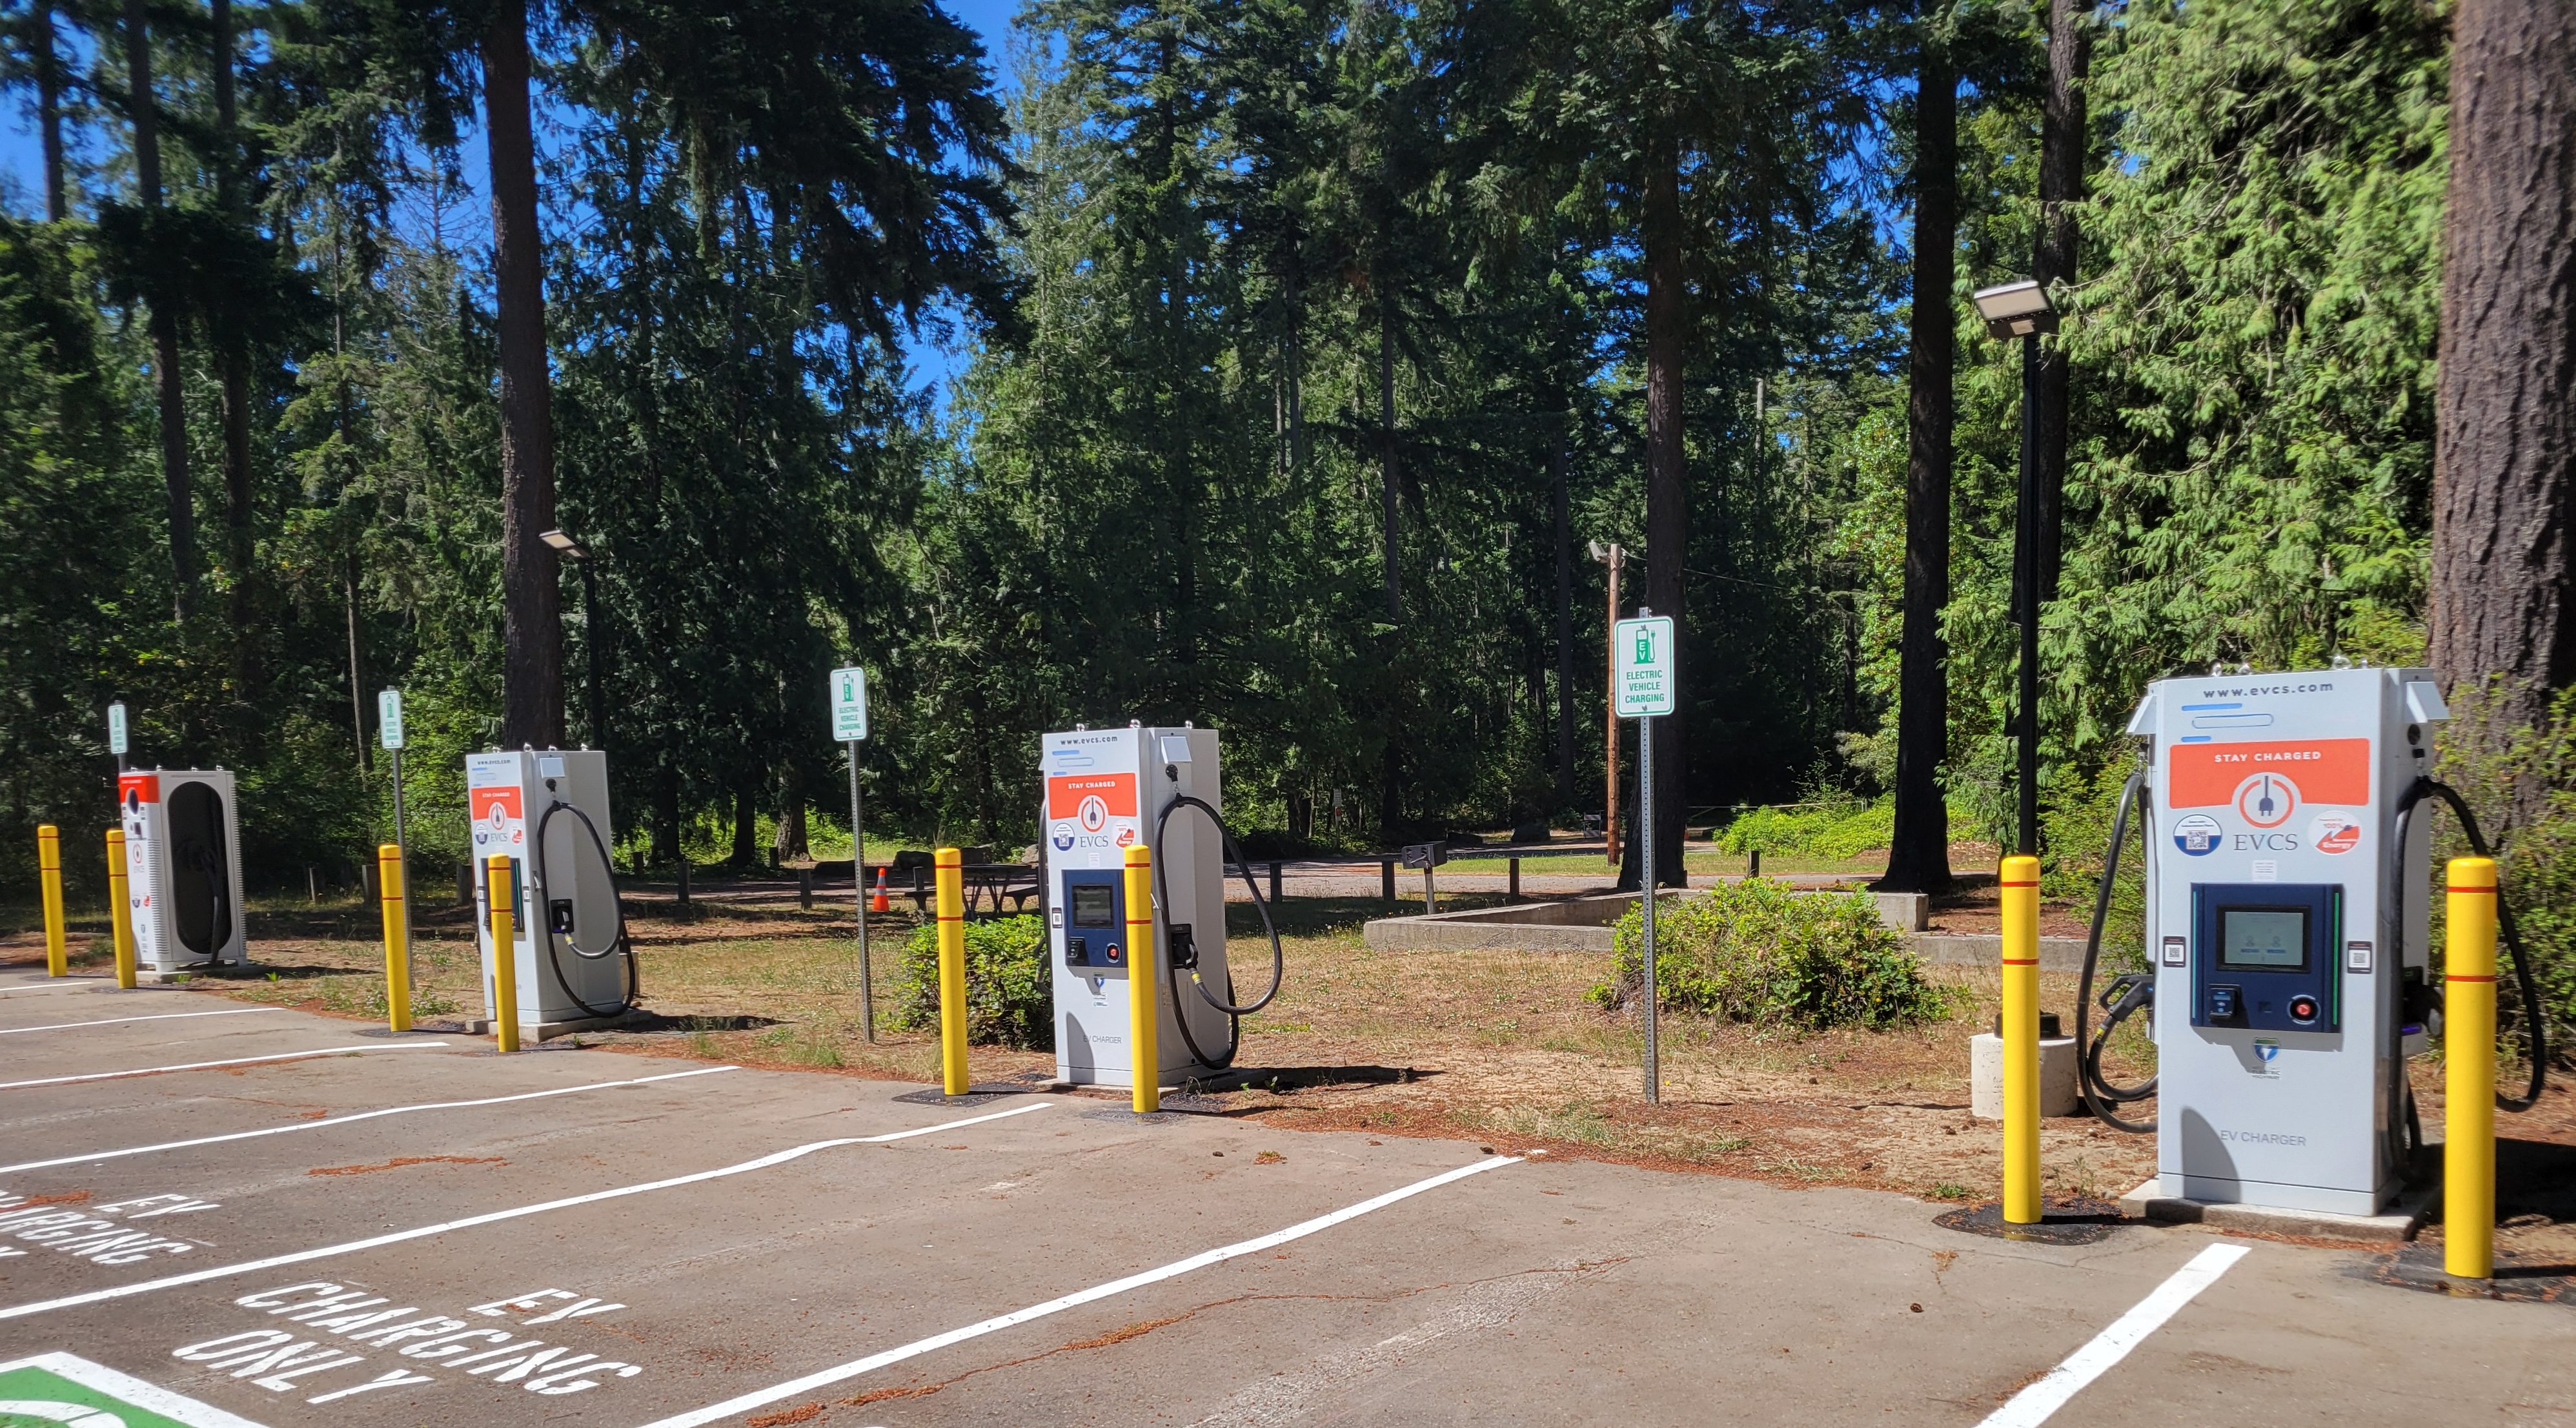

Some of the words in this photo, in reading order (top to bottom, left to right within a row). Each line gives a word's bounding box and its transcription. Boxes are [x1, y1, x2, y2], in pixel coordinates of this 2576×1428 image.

[1626, 670, 1663, 680] ELECTRIC
[1628, 682, 1661, 691] VEHICLE
[2203, 683, 2333, 698] www.evcs.com
[1625, 693, 1665, 704] CHARGING
[1060, 736, 1118, 745] www.evcs.com
[2215, 753, 2247, 762] STAY
[2254, 751, 2322, 761] CHARGED
[1080, 835, 1109, 848] EVCS
[2233, 833, 2298, 851] EVCS
[1092, 1035, 1122, 1044] CHARGER
[2220, 1130, 2238, 1140] EV
[2241, 1132, 2306, 1146] CHARGER
[235, 1282, 642, 1395] CHARGING
[172, 1330, 434, 1404] ONLY
